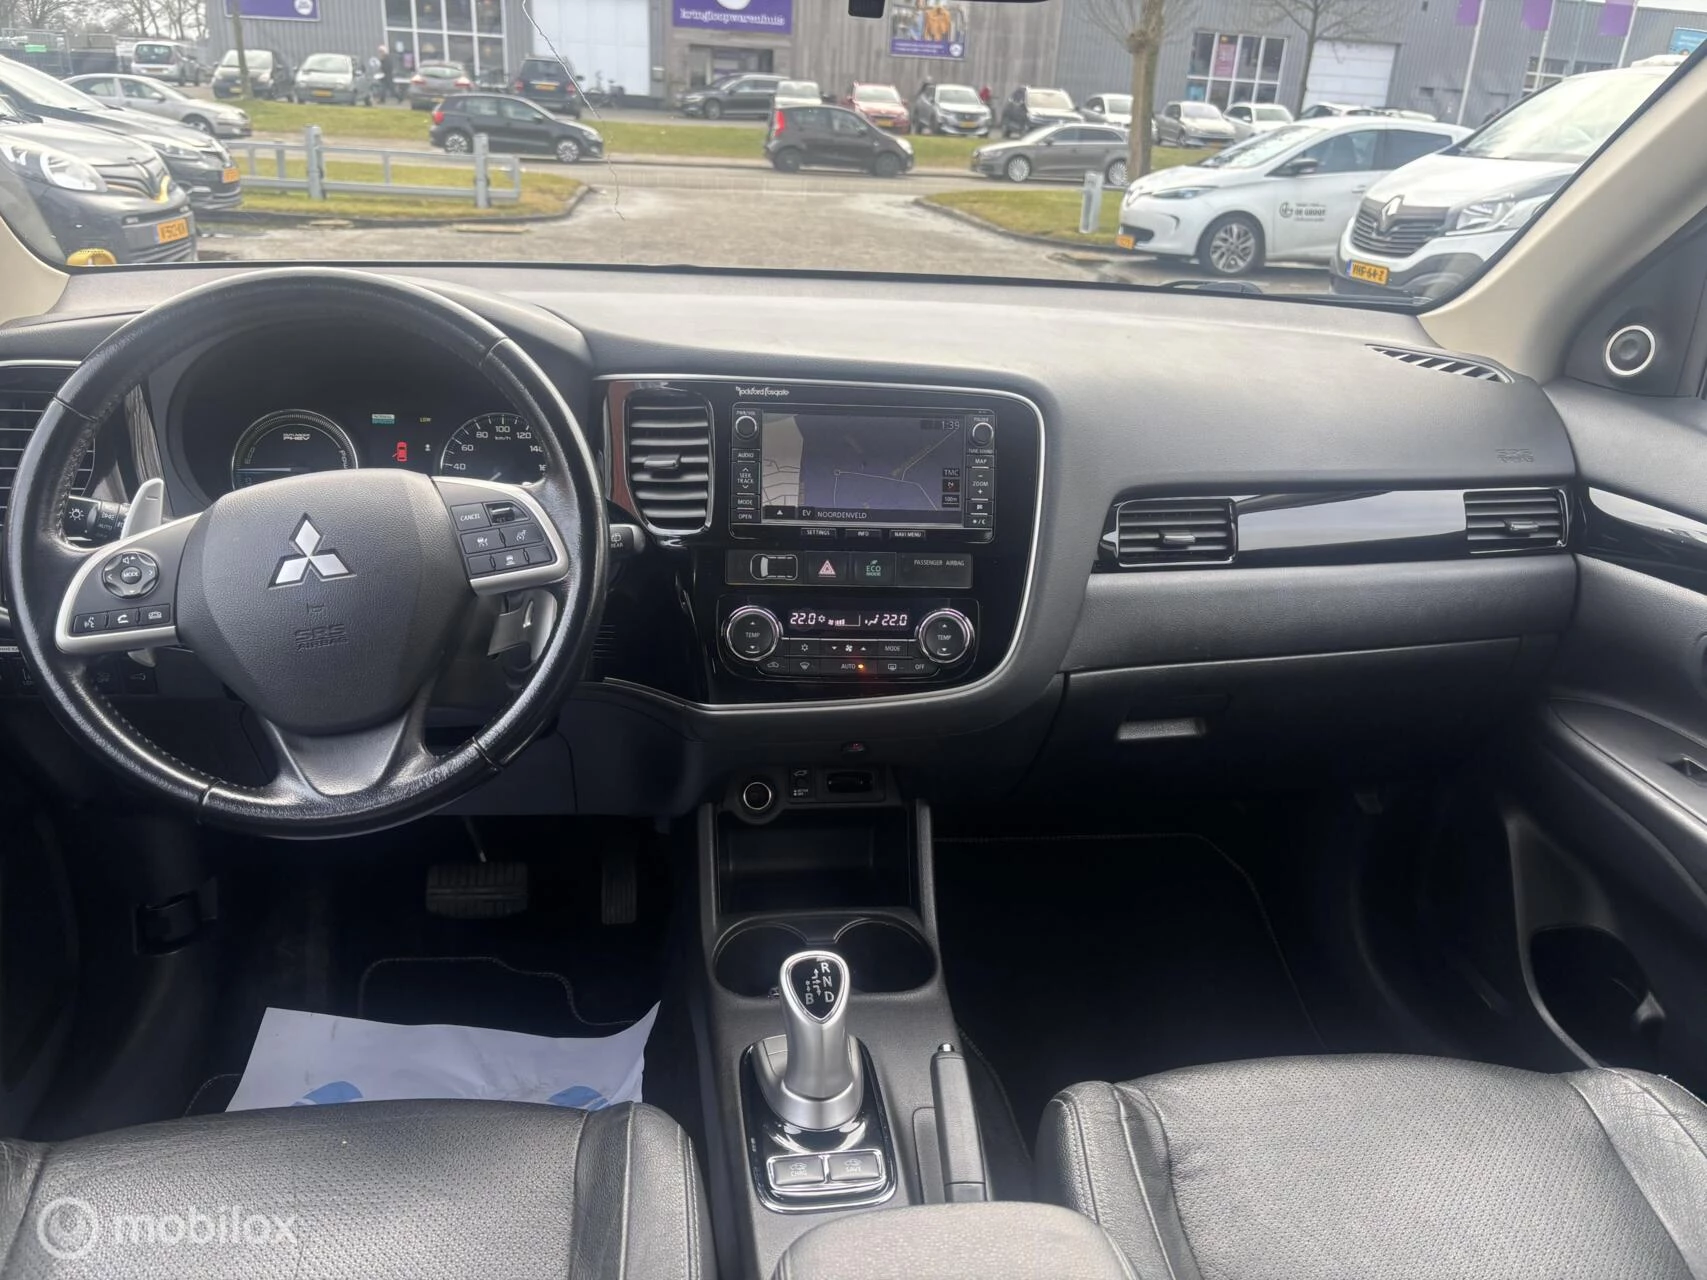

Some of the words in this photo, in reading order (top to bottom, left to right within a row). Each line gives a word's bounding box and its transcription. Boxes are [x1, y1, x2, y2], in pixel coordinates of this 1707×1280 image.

[495, 425, 511, 433] 100
[475, 431, 489, 439] 80
[516, 432, 532, 440] 120
[461, 444, 474, 452] 60
[453, 463, 467, 471] 40
[460, 513, 481, 522] CANCEL
[802, 509, 812, 517] EV
[817, 511, 867, 519] NOORDENVELD
[913, 559, 943, 567] PASSENGER
[789, 612, 817, 625] 22.0
[881, 614, 908, 626] 22.0
[820, 962, 831, 974] R
[822, 976, 833, 987] N
[805, 993, 815, 1005] B
[824, 991, 835, 1003] D
